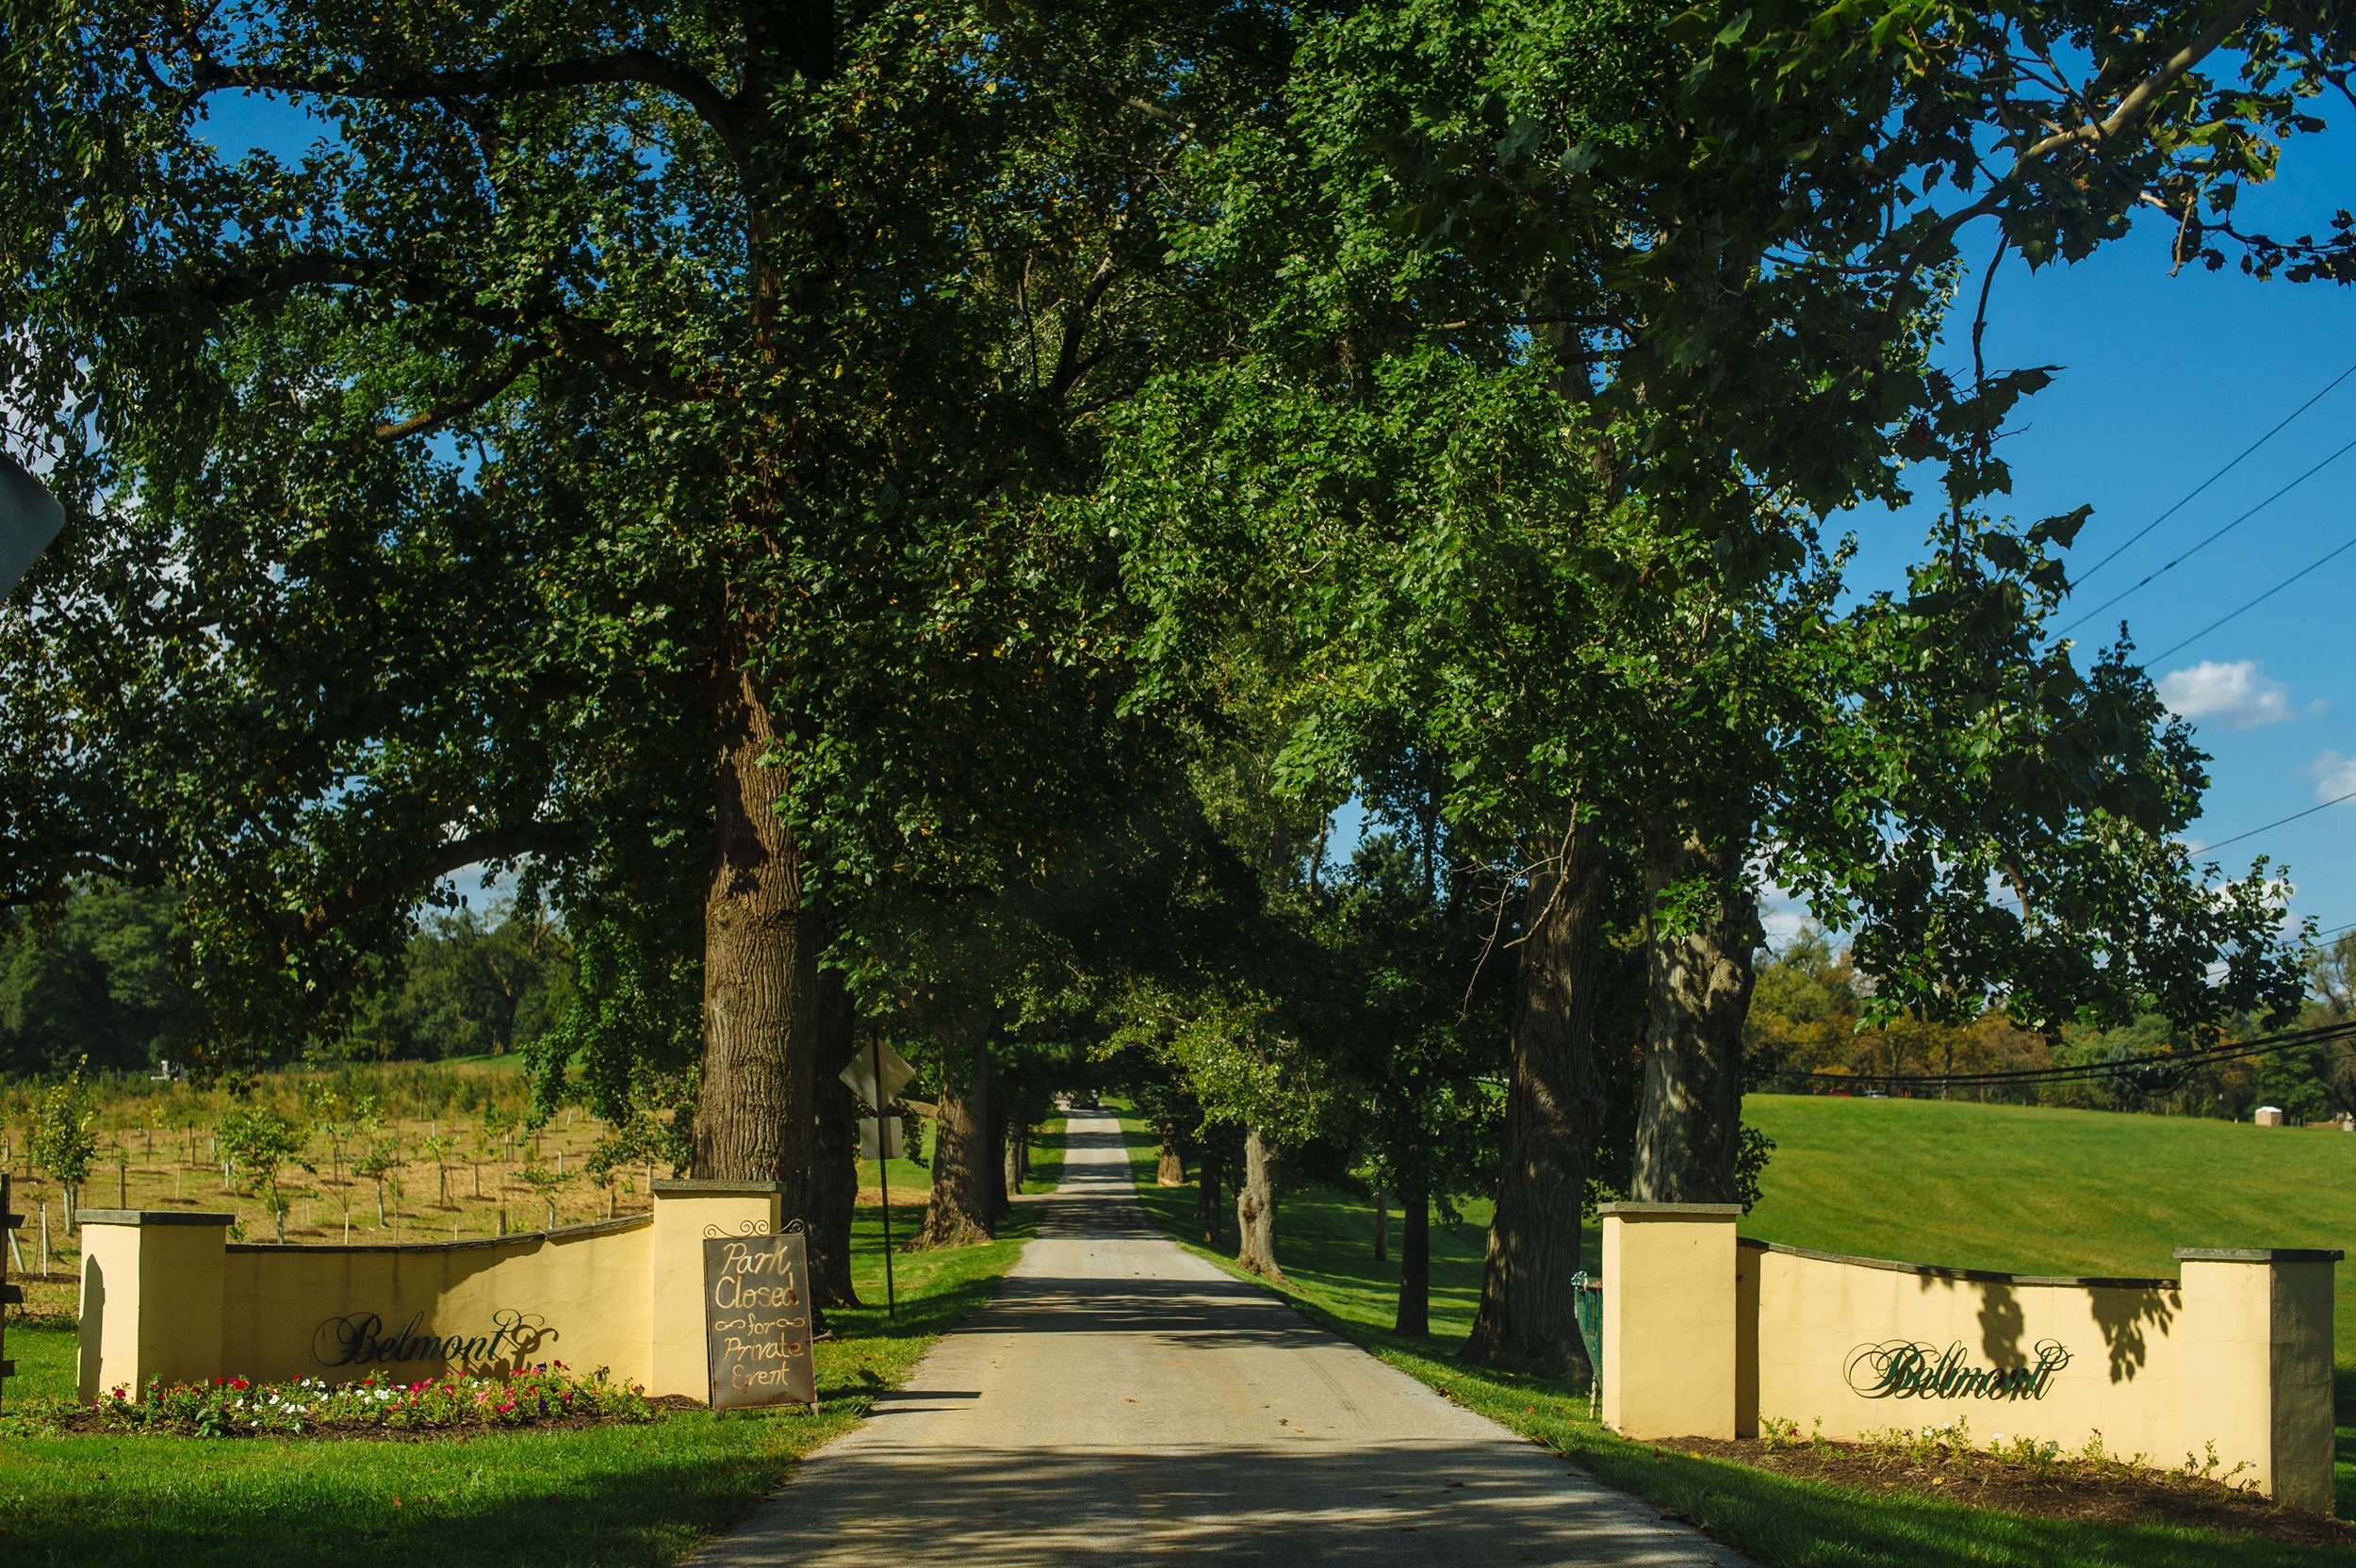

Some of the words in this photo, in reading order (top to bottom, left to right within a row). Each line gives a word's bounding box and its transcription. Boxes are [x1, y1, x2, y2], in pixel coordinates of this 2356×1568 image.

[721, 1242, 792, 1275] Park
[715, 1273, 800, 1309] Closed
[312, 1308, 545, 1366] Belmont
[747, 1313, 776, 1336] for
[723, 1332, 804, 1362] Private
[732, 1361, 790, 1389] Event
[1843, 1338, 2069, 1395] Belmont
